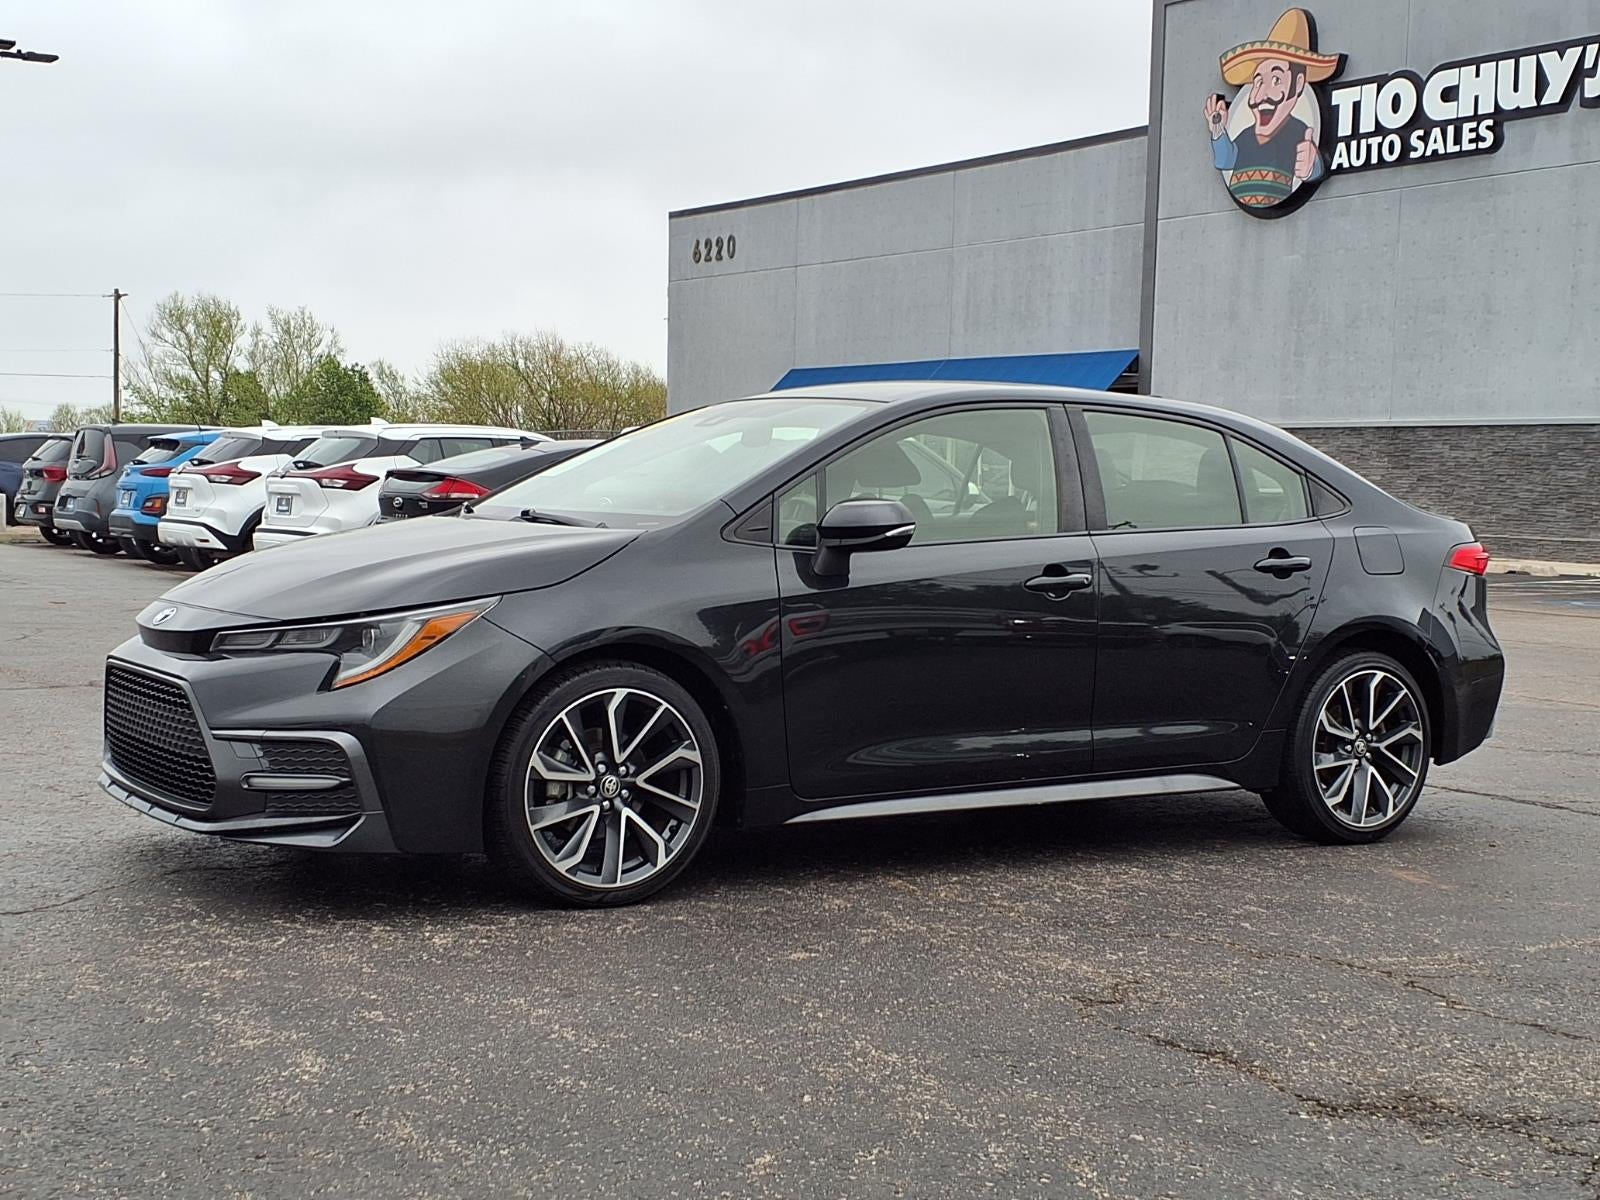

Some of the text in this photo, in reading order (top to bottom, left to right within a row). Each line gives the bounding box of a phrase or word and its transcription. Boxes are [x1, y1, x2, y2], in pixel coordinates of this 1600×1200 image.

[1331, 77, 1418, 137] TIO
[1330, 118, 1495, 170] AUTO SALES
[692, 233, 737, 265] 6220
